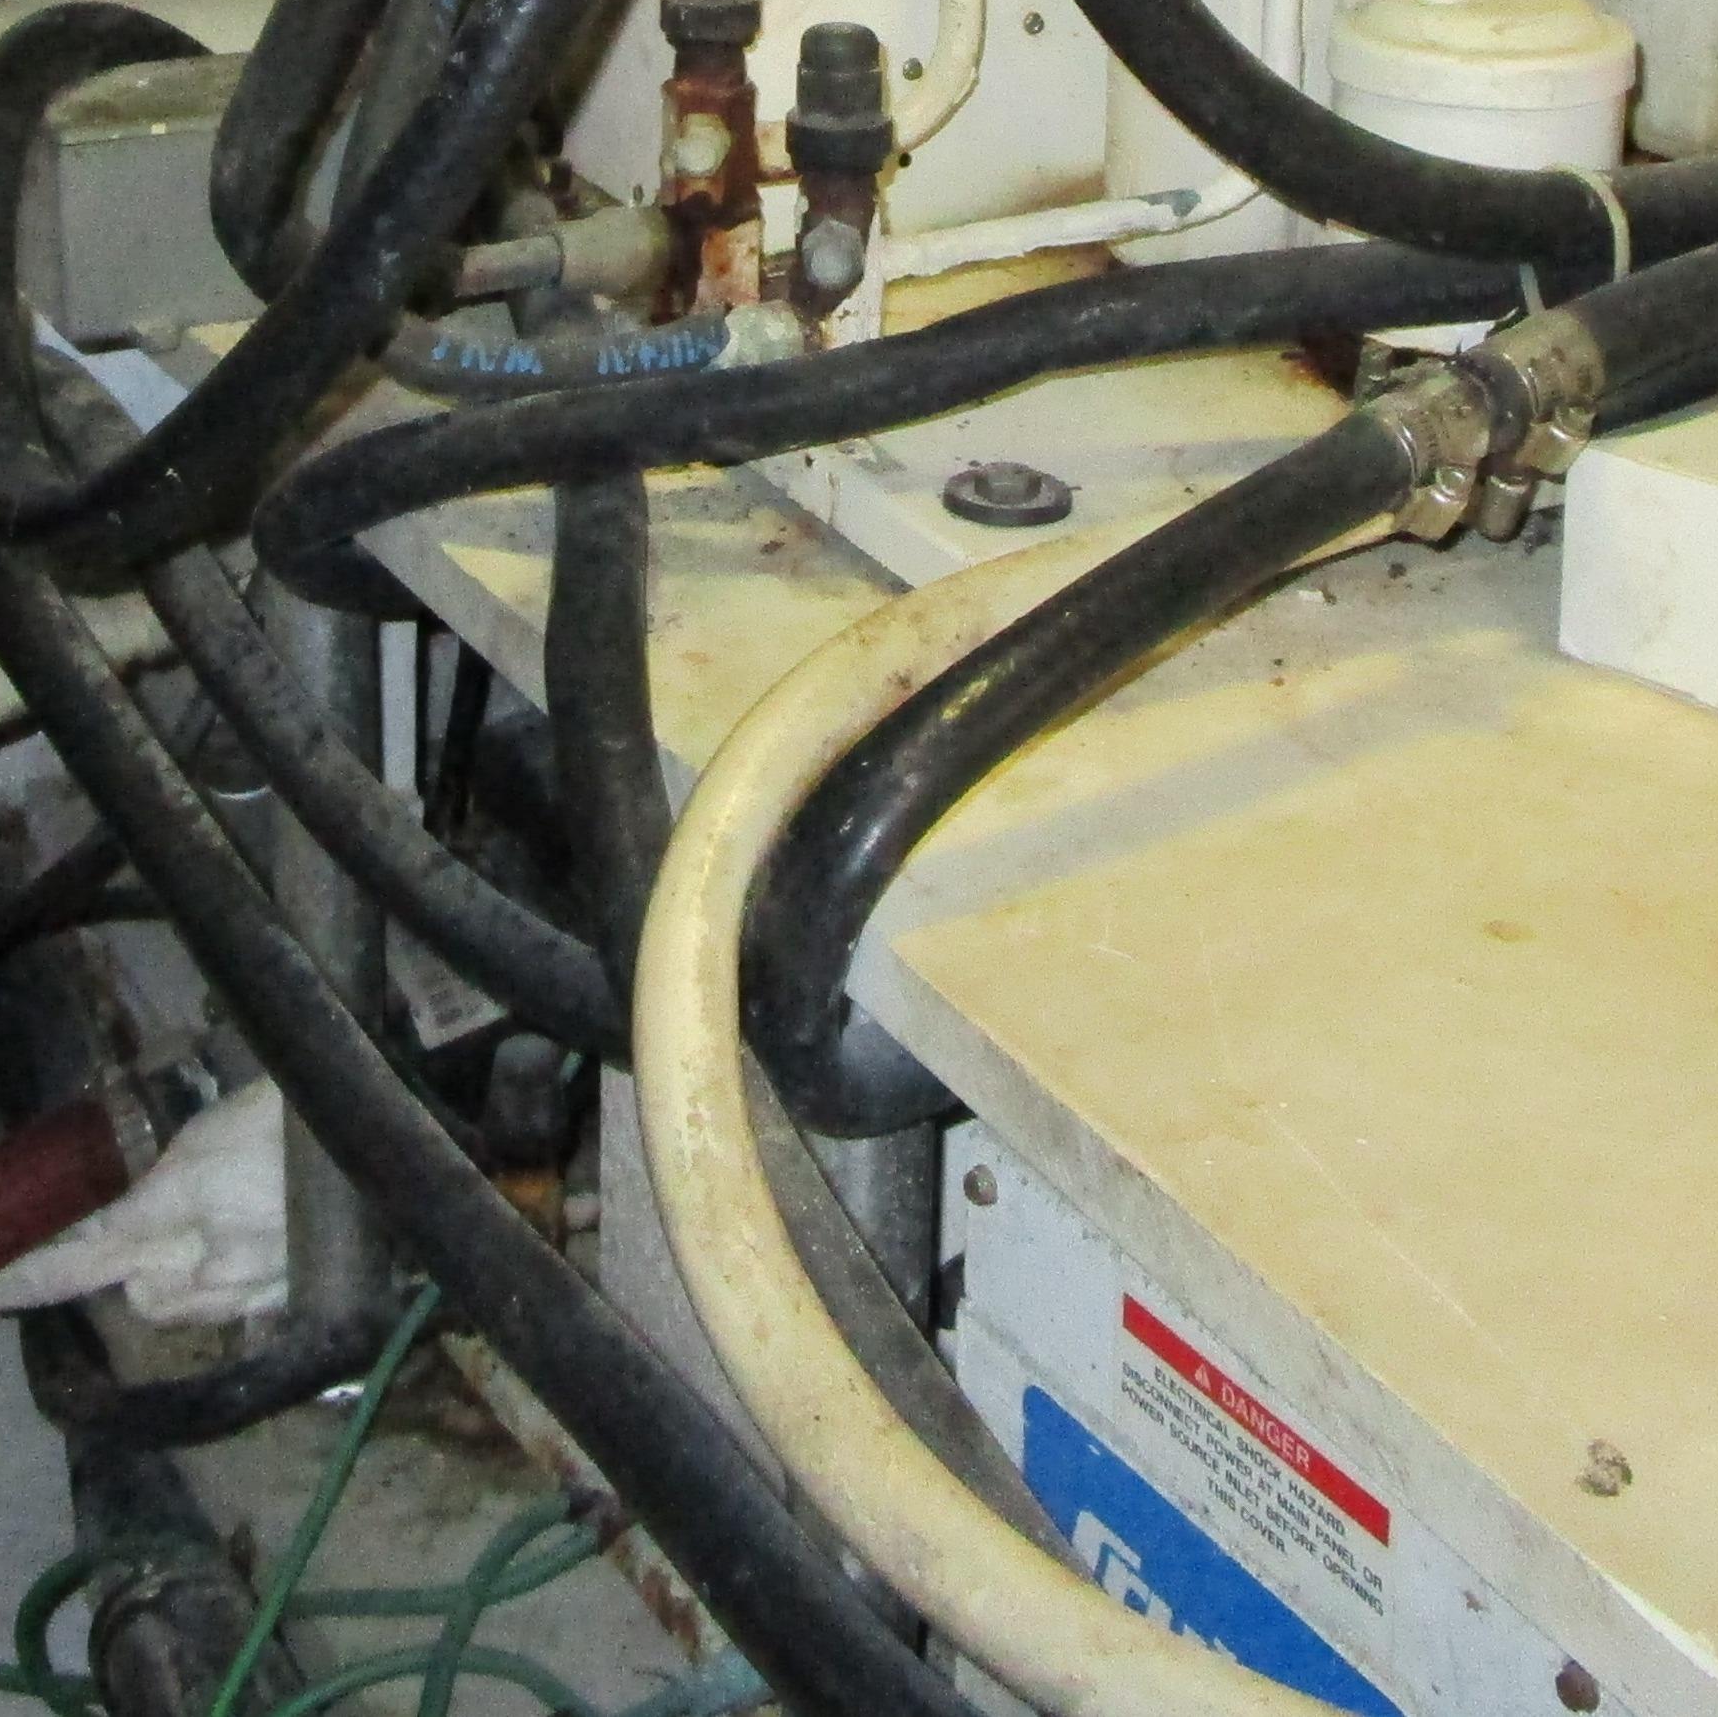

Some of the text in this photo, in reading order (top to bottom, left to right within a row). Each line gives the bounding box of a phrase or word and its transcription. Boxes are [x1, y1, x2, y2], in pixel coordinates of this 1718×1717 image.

[1121, 1381, 1384, 1618] POWER SOURCE INLET BEFORE OPENING
[1122, 1361, 1384, 1593] DISCONNECT POWER AT MAIN PANEL OR
[1154, 1365, 1346, 1538] ELECTRICAL SHOCK HAZARD
[1206, 1476, 1237, 1513] THIS
[1221, 1383, 1311, 1472] DANGER
